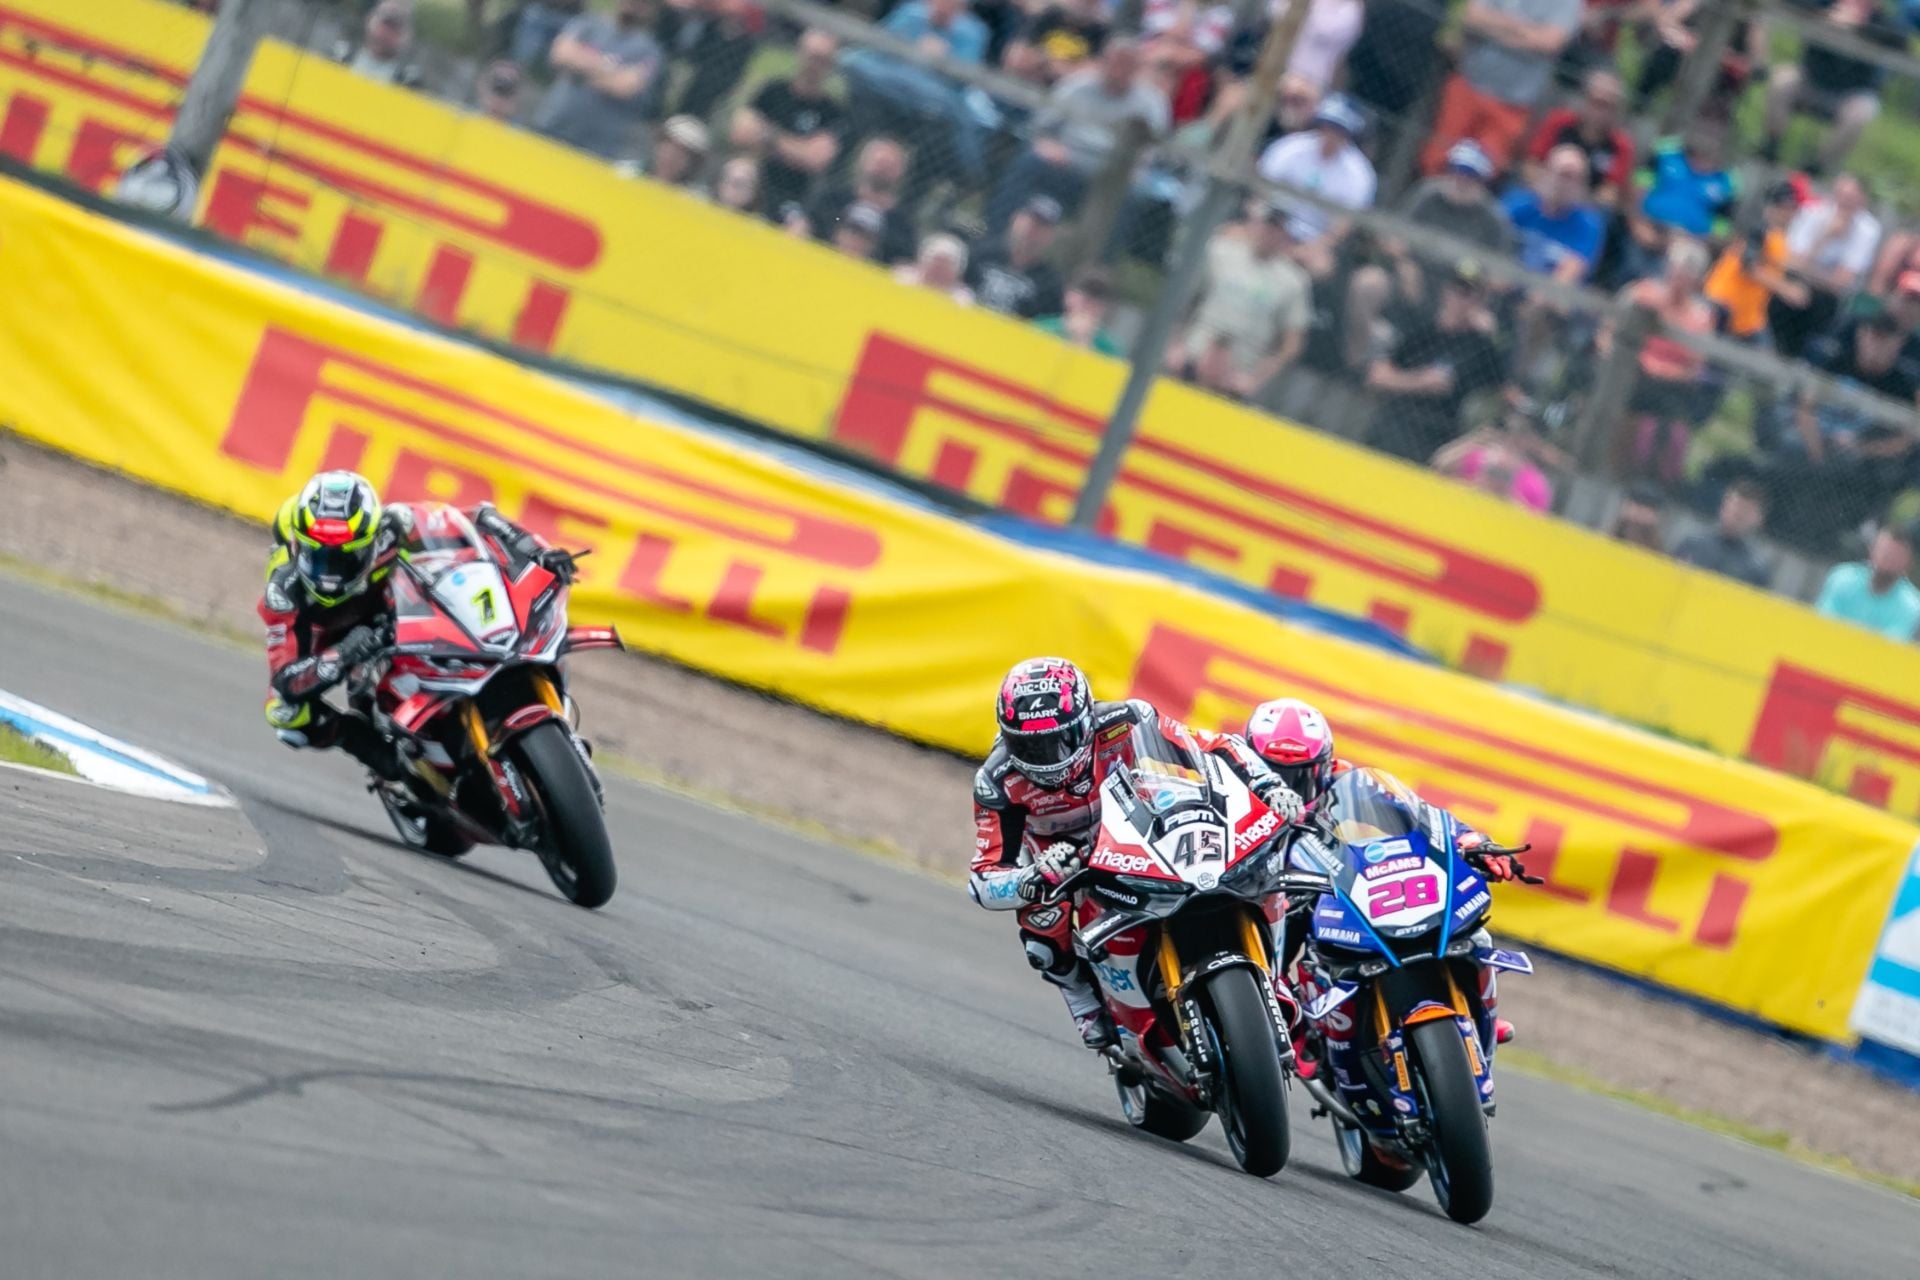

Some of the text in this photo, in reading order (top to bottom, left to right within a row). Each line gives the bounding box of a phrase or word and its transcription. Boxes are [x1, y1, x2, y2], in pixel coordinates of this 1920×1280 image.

[220, 325, 883, 657] PIRELLI
[470, 586, 496, 625] 1
[1018, 708, 1058, 720] SHARK
[1131, 622, 1780, 954] PLLI
[1164, 809, 1214, 833] PBM
[1173, 829, 1222, 869] 45
[1365, 856, 1422, 879] McAMS
[1367, 874, 1440, 919] 28
[1454, 890, 1491, 921] YAMAHA
[1317, 925, 1361, 944] YAMAHA
[1184, 999, 1208, 1063] PIRELLI
